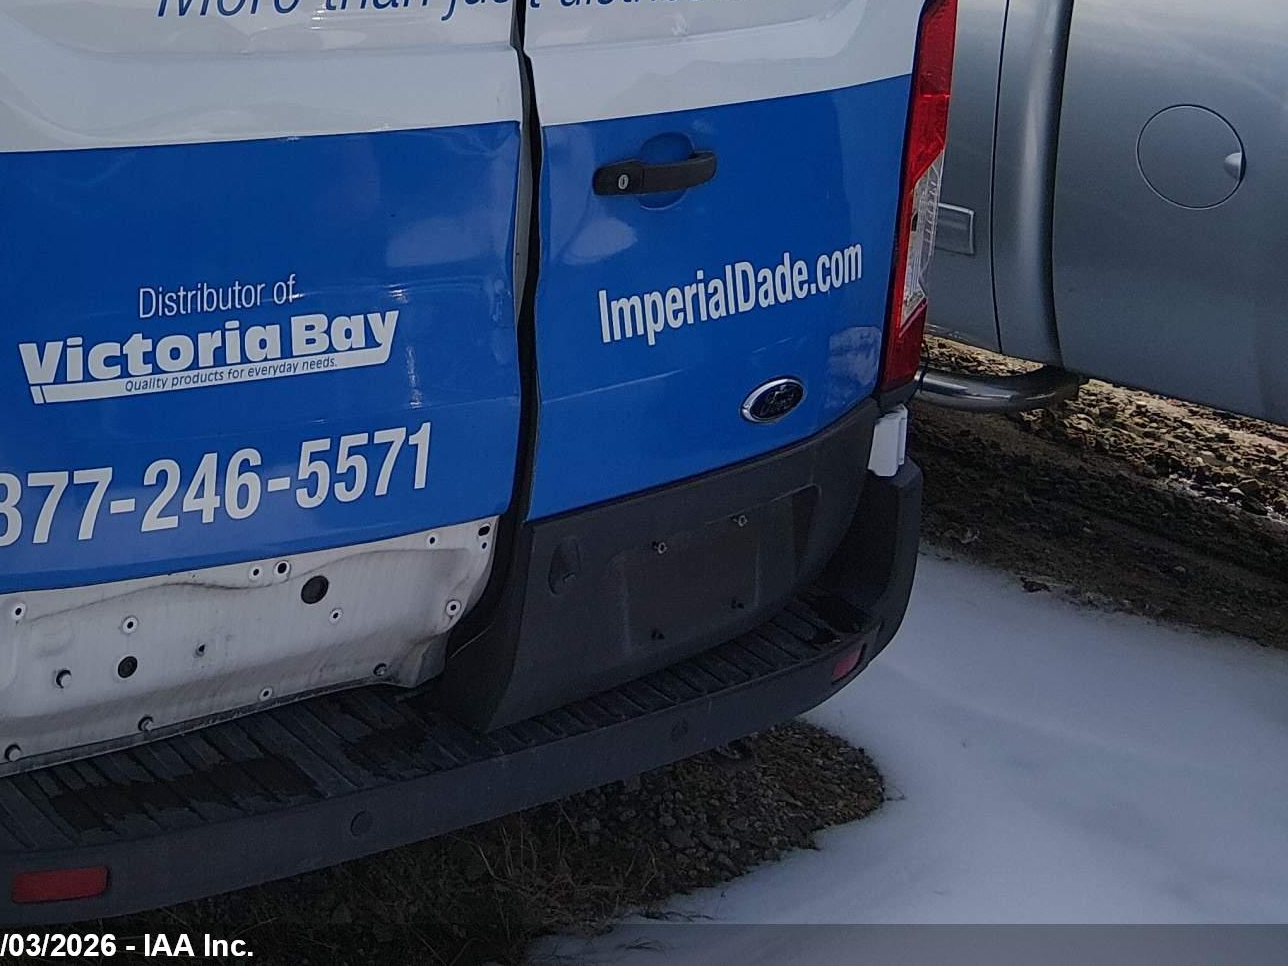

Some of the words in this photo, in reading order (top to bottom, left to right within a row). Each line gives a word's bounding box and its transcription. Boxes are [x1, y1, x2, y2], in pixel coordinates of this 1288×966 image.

[138, 278, 265, 319] Distributor
[273, 273, 297, 304] of
[598, 242, 863, 347] ImperialDade.com
[18, 319, 282, 385] Victoria
[291, 309, 400, 360] Bay
[124, 375, 169, 393] Quality
[170, 369, 224, 389] products
[226, 366, 244, 380] for
[247, 358, 299, 379] everyday
[302, 355, 338, 372] needs.
